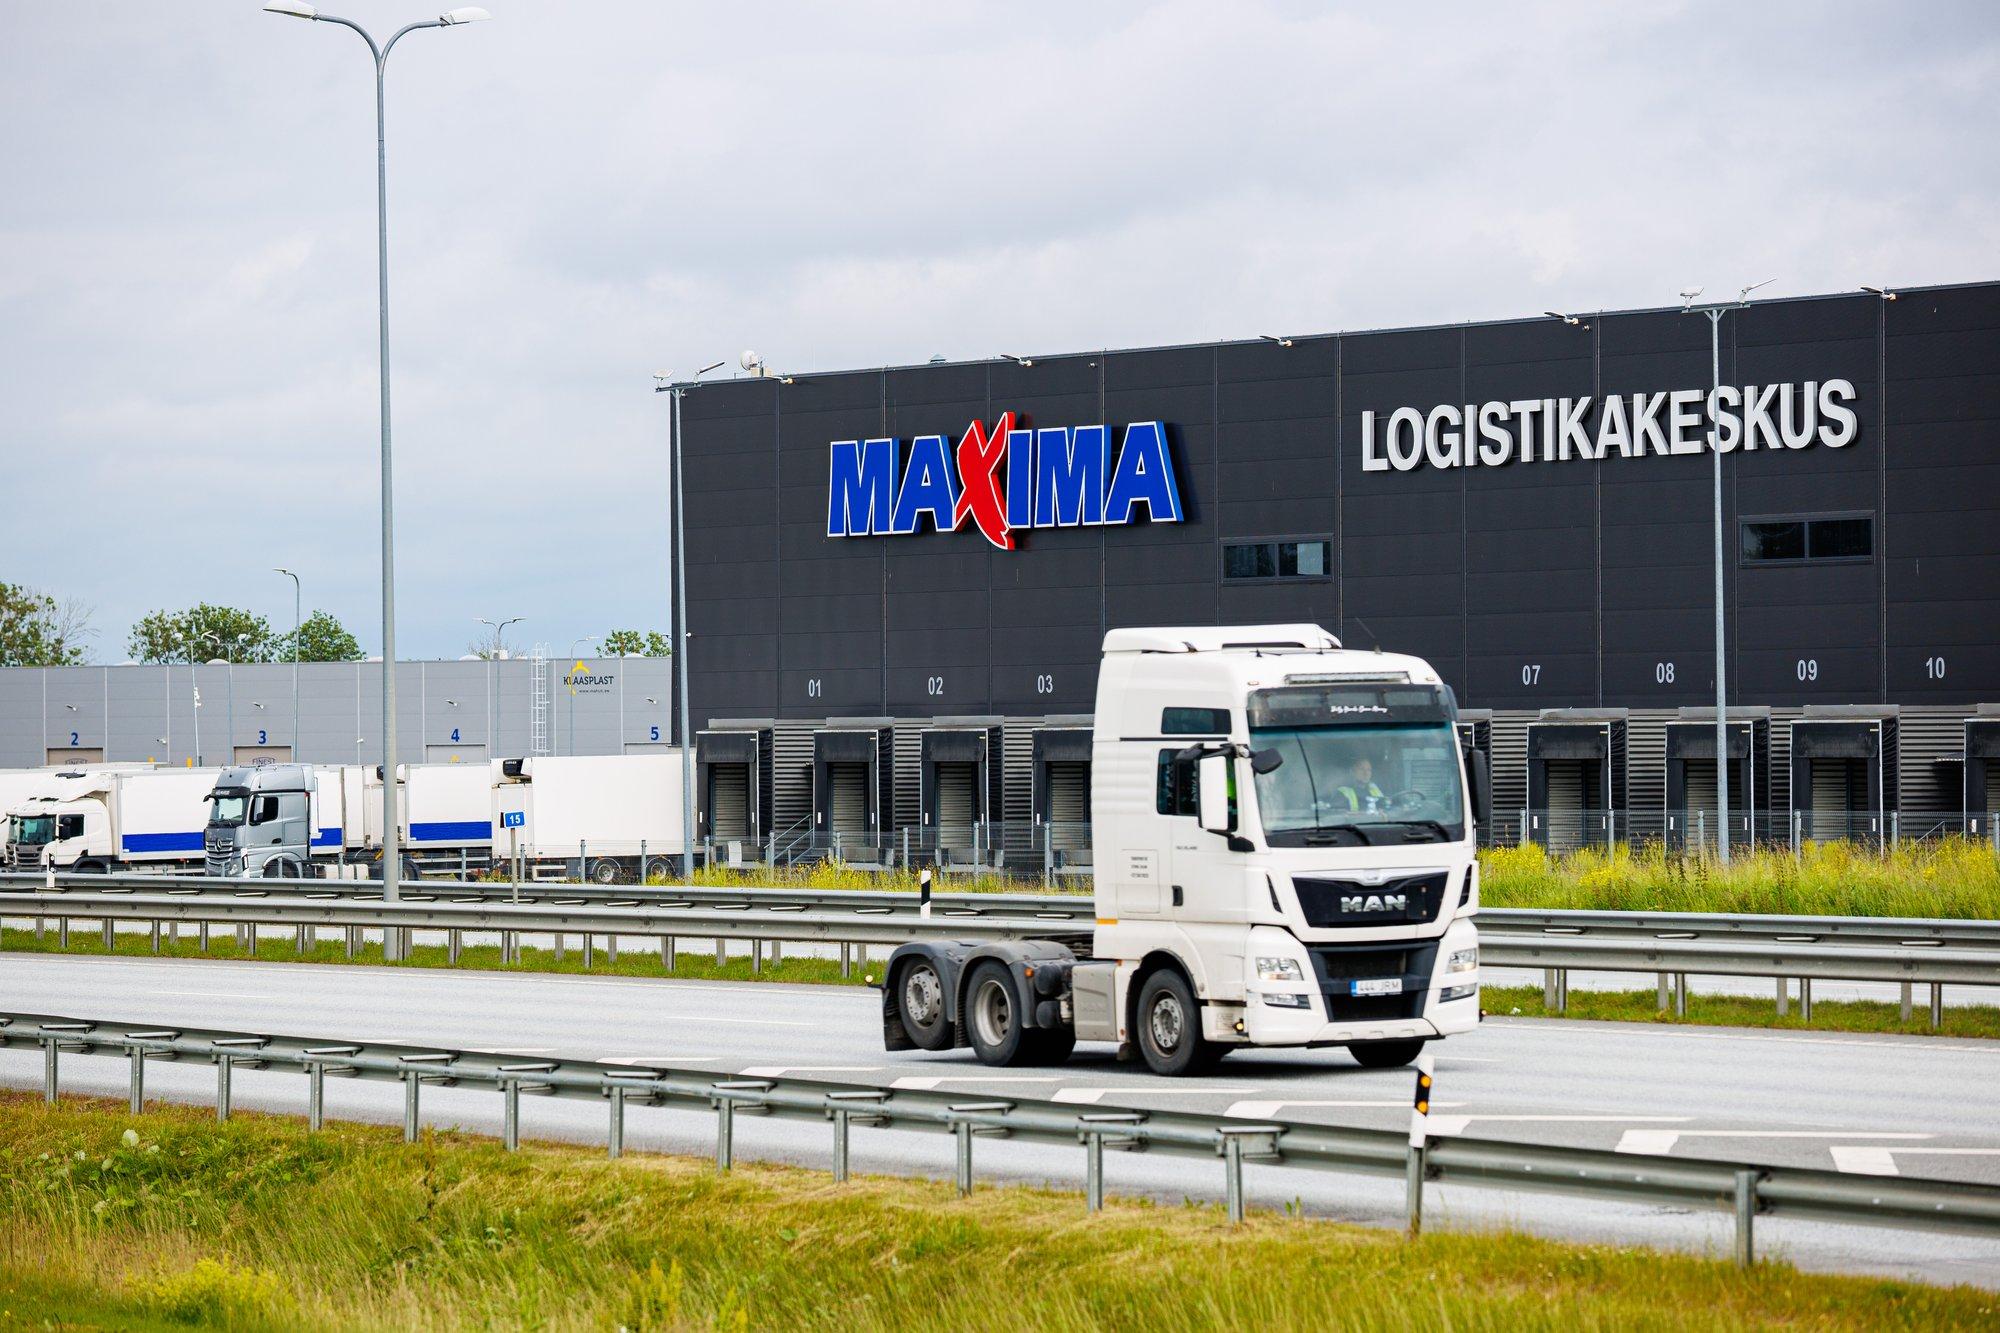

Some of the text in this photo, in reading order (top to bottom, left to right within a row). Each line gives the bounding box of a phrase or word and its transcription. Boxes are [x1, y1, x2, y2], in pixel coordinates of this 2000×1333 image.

[1361, 378, 1858, 473] LOGISTIKAKESKUS
[826, 411, 1184, 551] MAXIMA
[1522, 665, 1541, 685] 07
[1655, 662, 1675, 684] 08
[1796, 659, 1818, 681] 09
[1925, 656, 1946, 679] 10
[563, 675, 615, 686] KLAASPLAST
[808, 679, 822, 697] 01
[928, 676, 944, 695] 02
[1037, 674, 1054, 694] 03
[71, 732, 80, 746] 2
[258, 730, 267, 744] 3
[450, 728, 460, 742] 4
[650, 727, 660, 741] 5
[509, 815, 521, 825] 15
[1340, 895, 1406, 913] MAN
